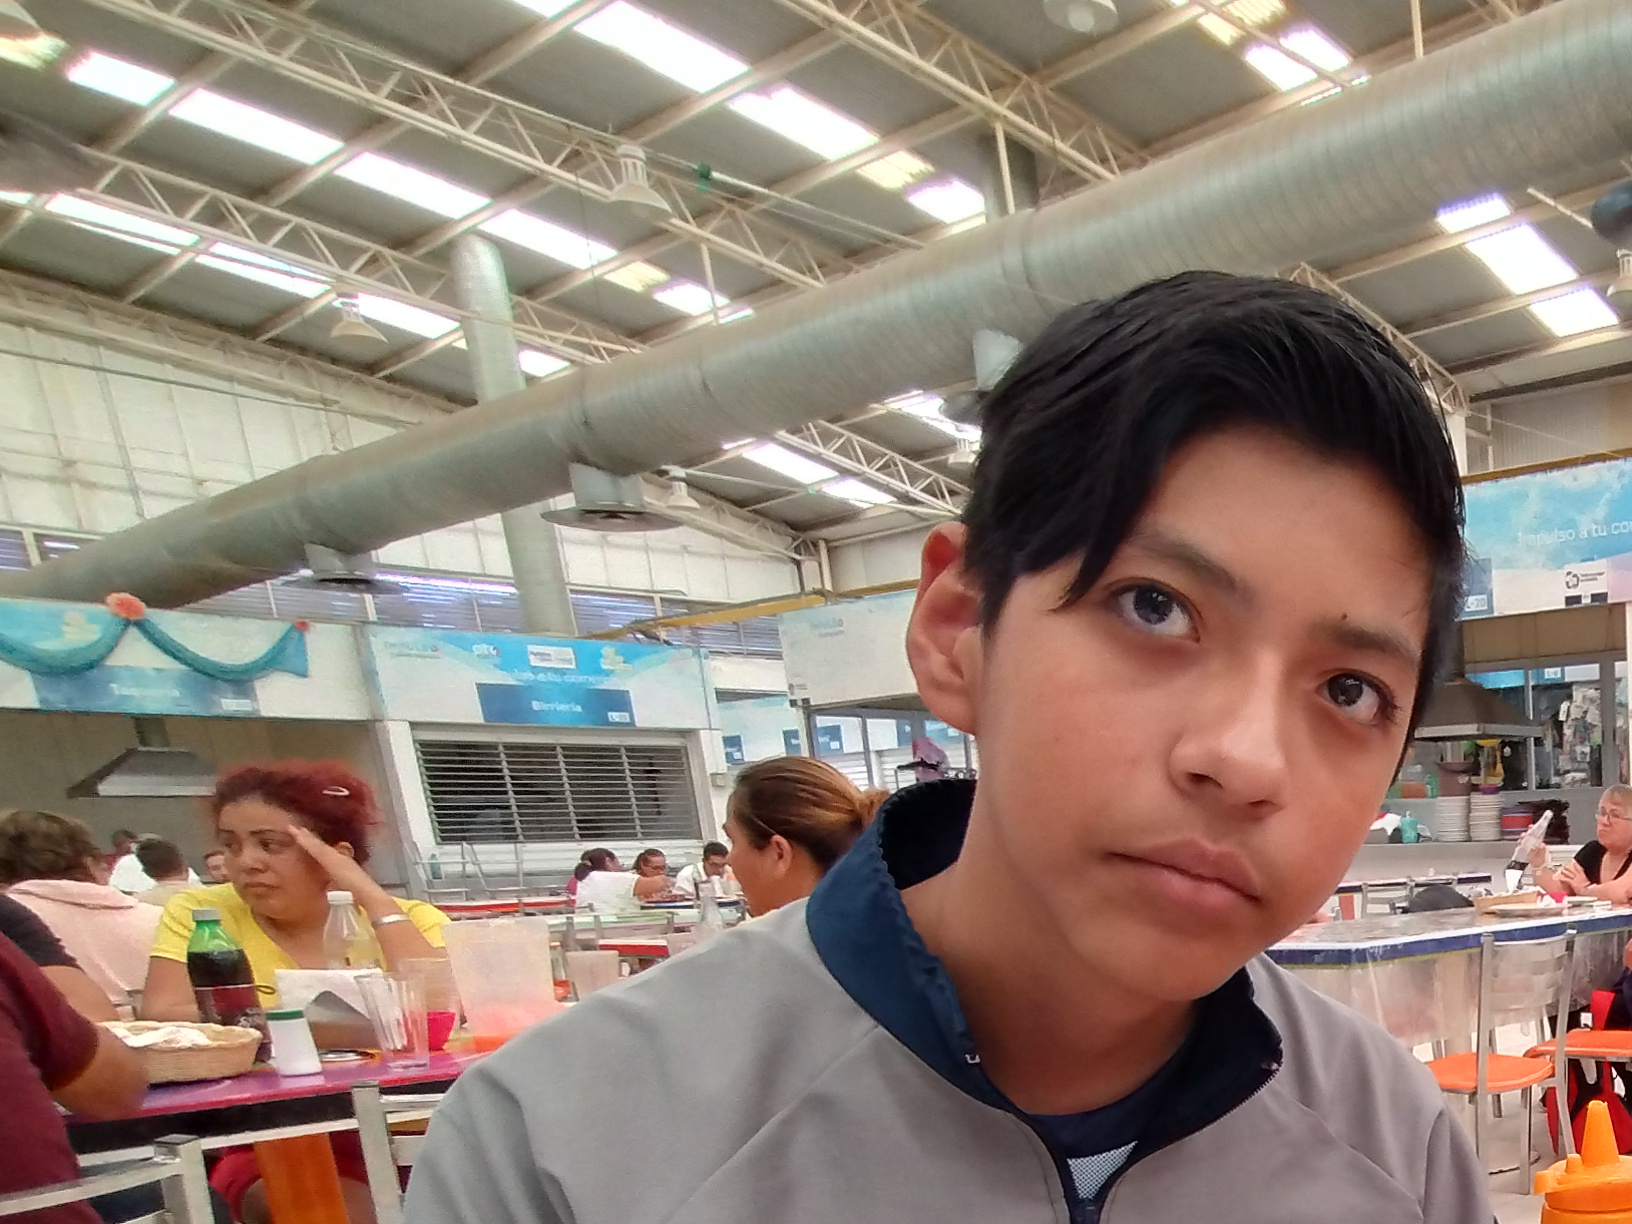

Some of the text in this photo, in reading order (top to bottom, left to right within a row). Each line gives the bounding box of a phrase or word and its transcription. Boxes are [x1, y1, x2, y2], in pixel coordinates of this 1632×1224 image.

[1517, 528, 1575, 548] Impulso
[1580, 527, 1588, 538] a
[1590, 525, 1607, 538] tu
